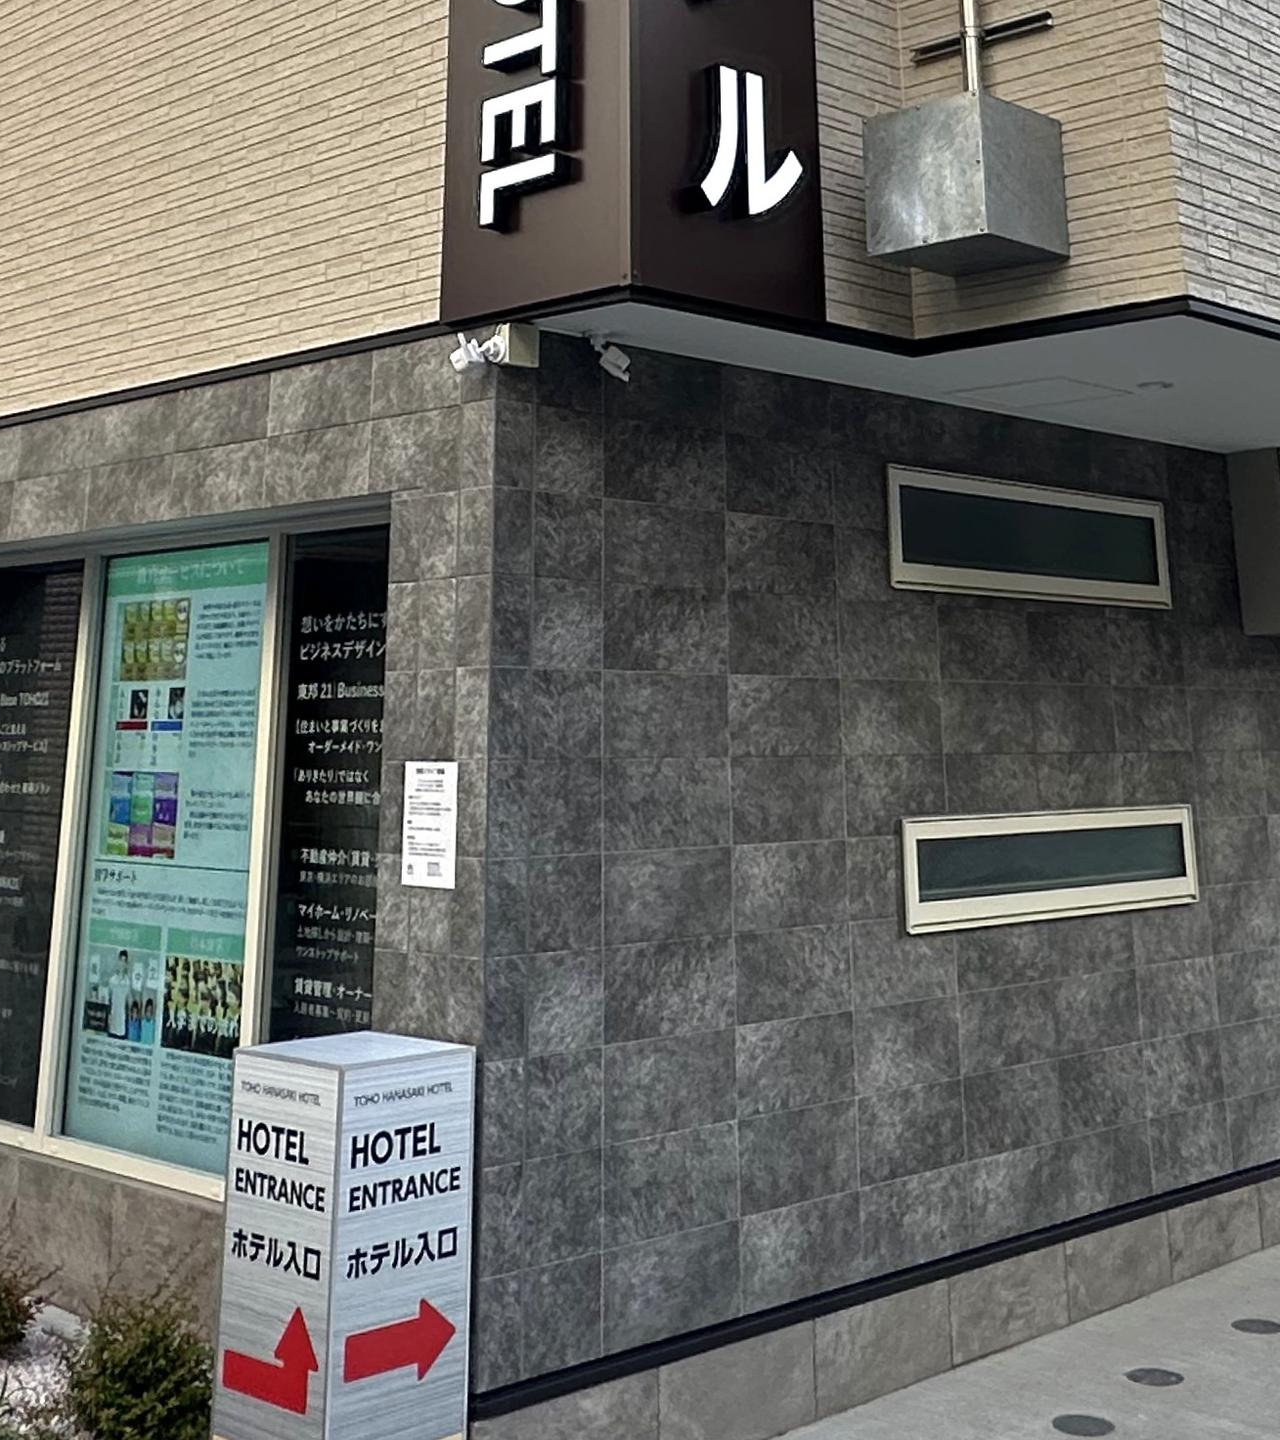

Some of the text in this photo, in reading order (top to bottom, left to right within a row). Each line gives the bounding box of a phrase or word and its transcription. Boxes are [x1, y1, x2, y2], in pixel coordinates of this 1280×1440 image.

[300, 640, 386, 661] ビジネスデザイン
[353, 1093, 380, 1107] TOHO
[236, 1118, 309, 1166] HOTEL
[350, 1122, 442, 1170] HOTEL
[235, 1167, 326, 1213] ENTRANCE
[348, 1166, 462, 1213] ENTRANCE
[231, 1228, 321, 1281] ホテル入口
[346, 1226, 458, 1280] ホテル入口
